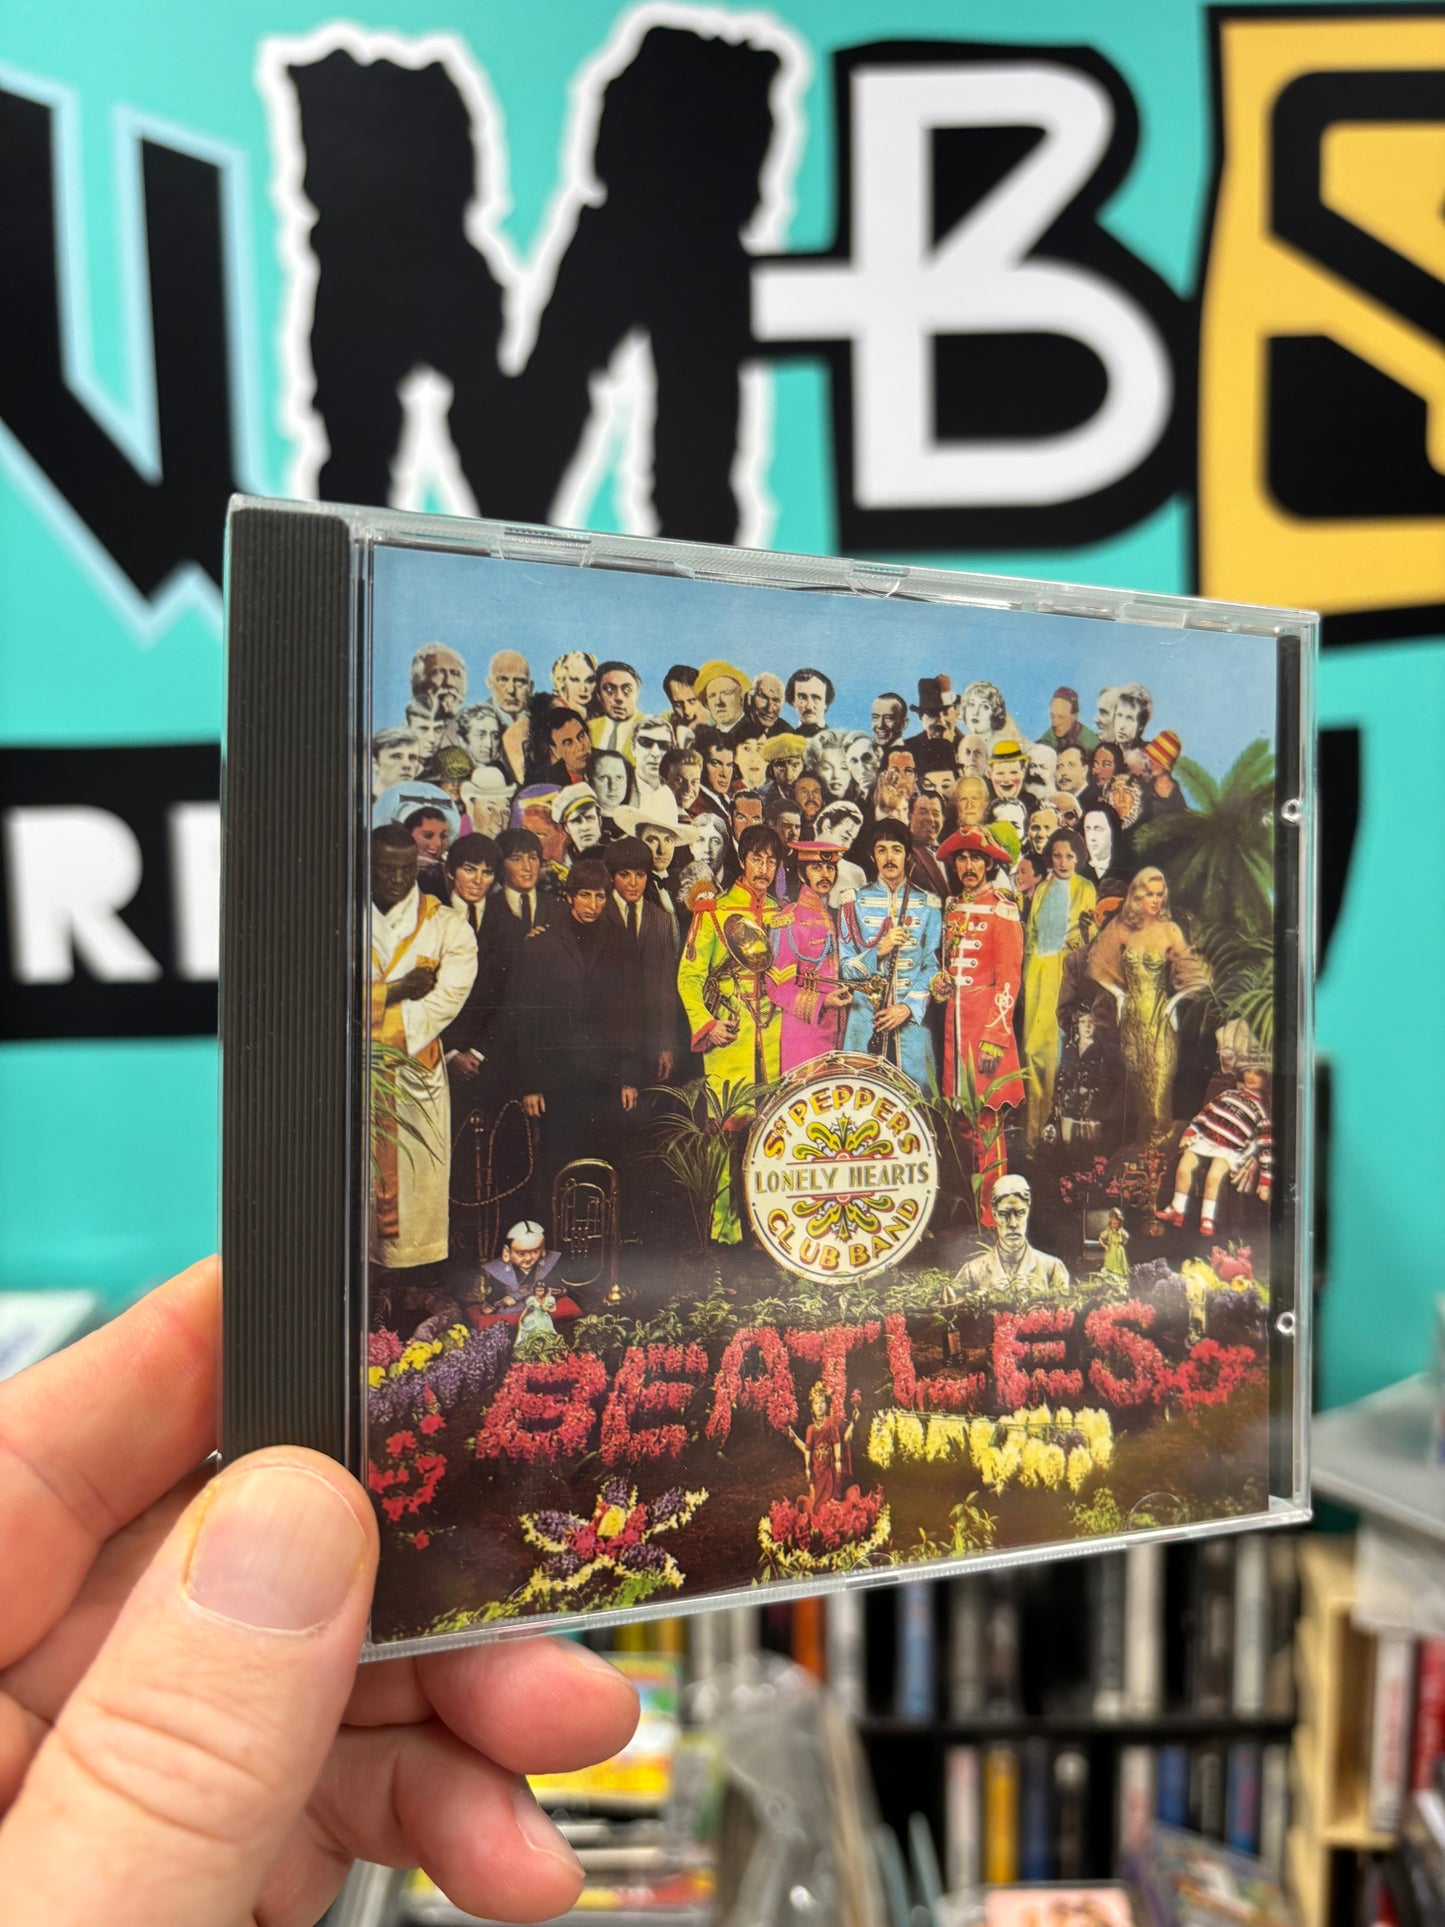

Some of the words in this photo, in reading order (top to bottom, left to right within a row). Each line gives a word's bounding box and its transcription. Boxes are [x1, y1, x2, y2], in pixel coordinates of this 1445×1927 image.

[788, 1084, 921, 1156] PEPPERS
[755, 1167, 838, 1194] LONELY
[848, 1162, 930, 1189] HEARTS
[767, 1208, 840, 1271] CLUB
[849, 1198, 919, 1268] BAND
[475, 1298, 1164, 1466] BEATLES
